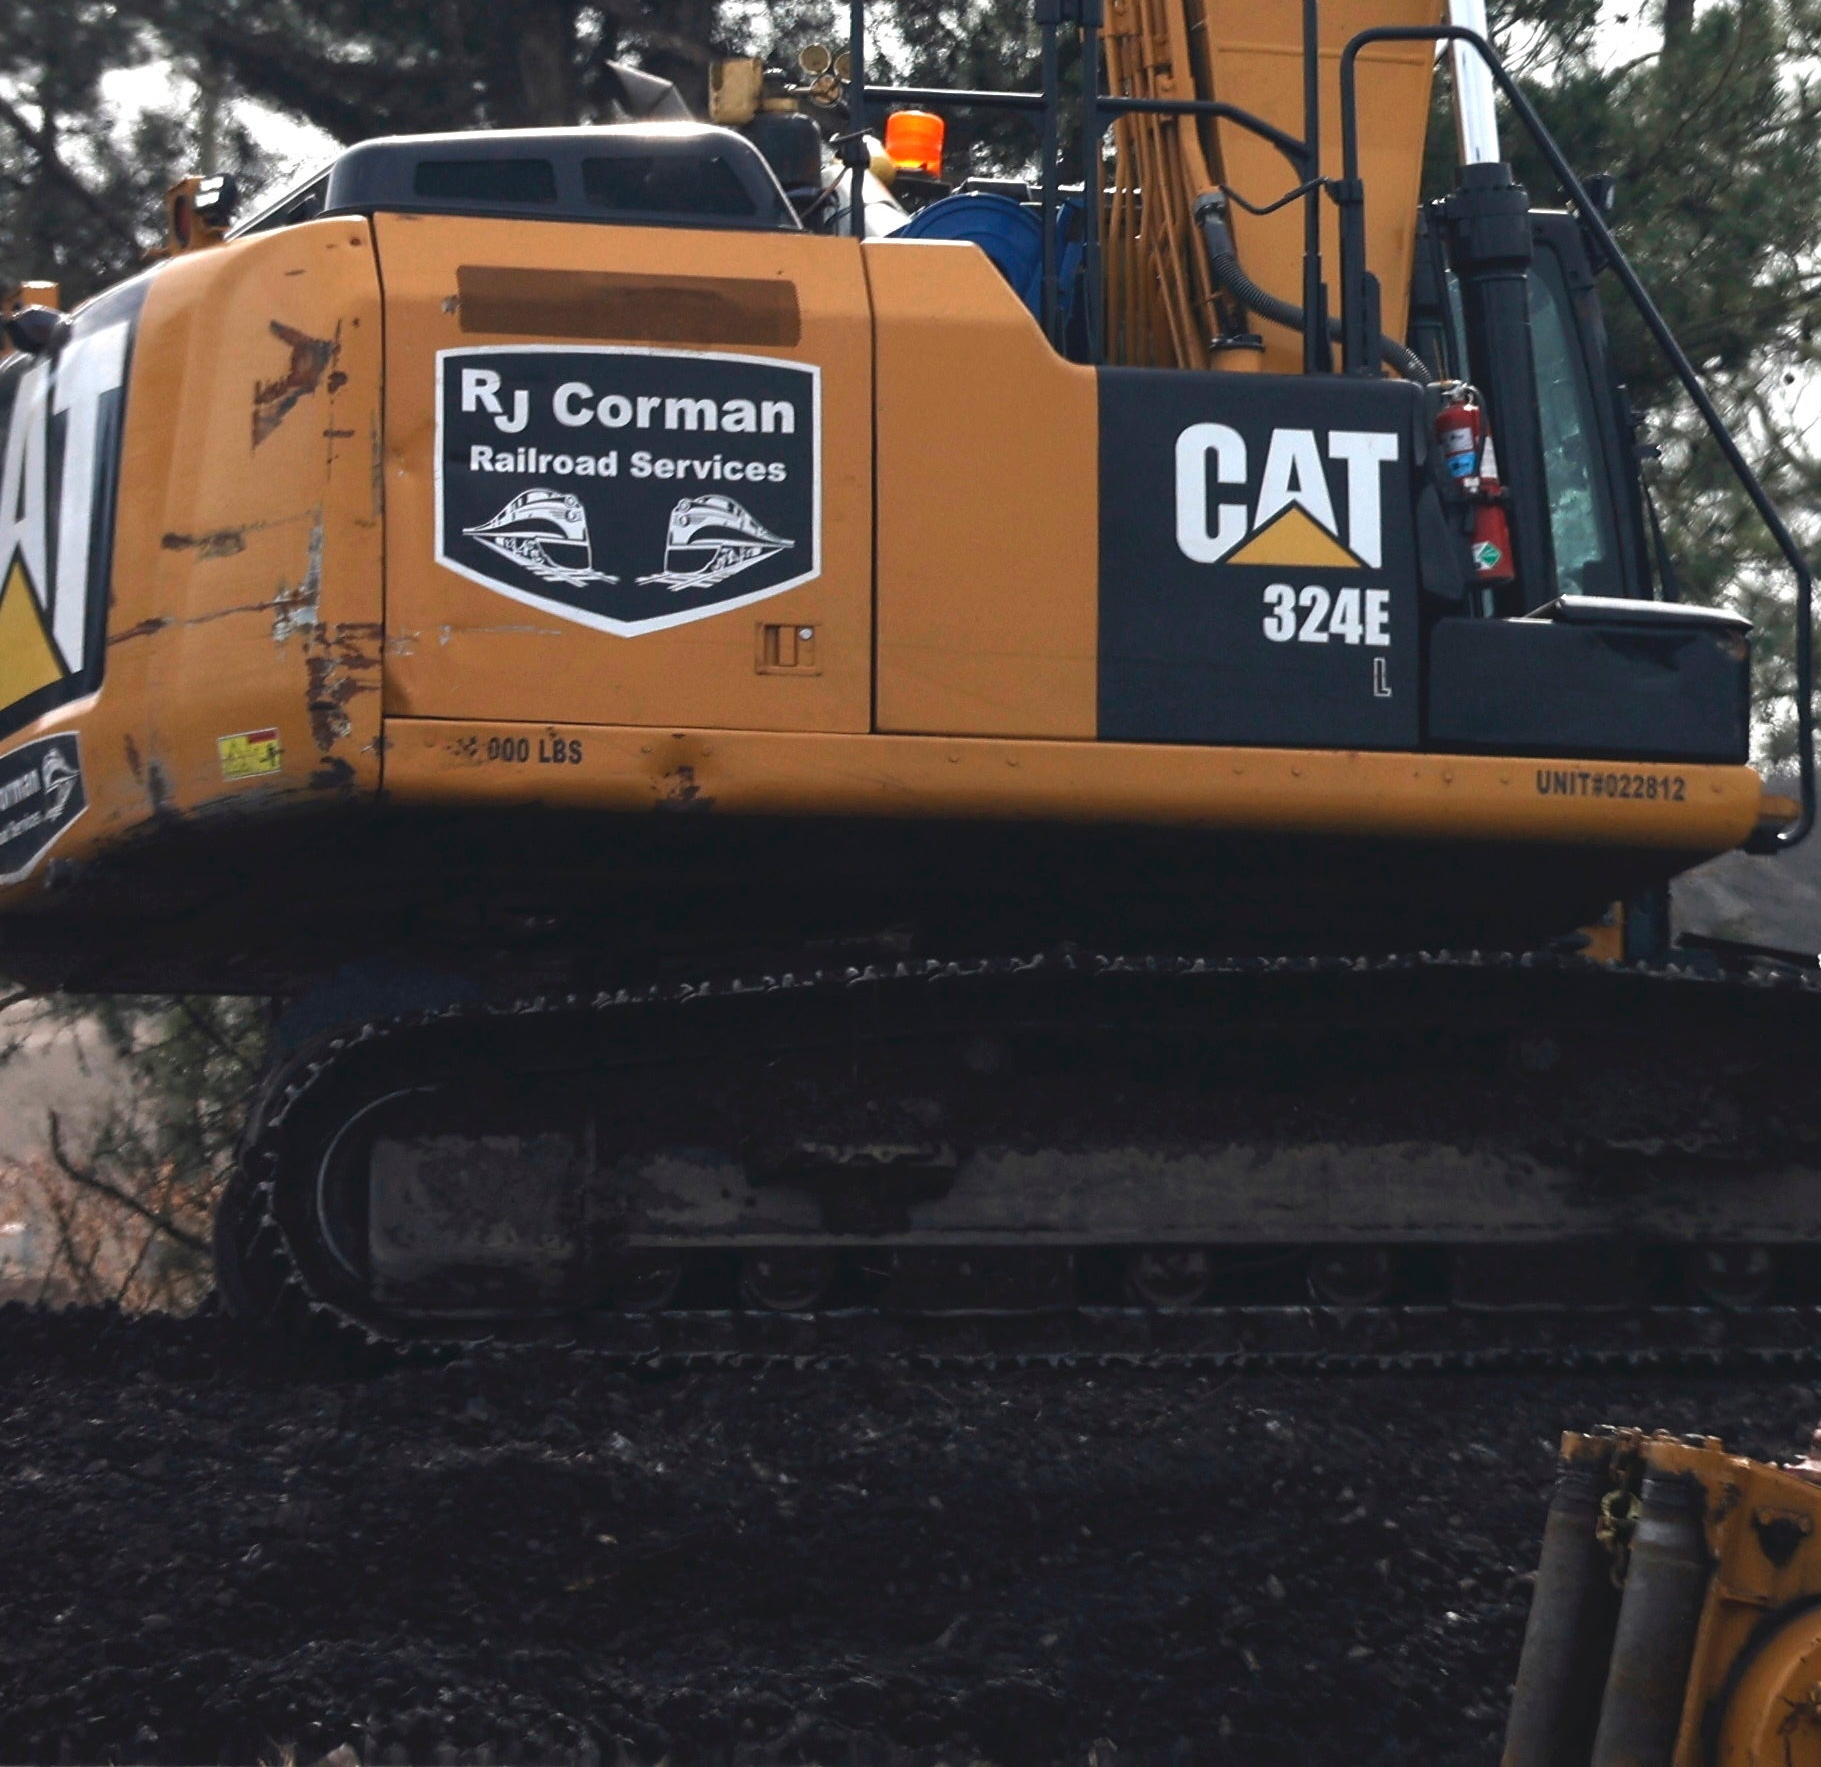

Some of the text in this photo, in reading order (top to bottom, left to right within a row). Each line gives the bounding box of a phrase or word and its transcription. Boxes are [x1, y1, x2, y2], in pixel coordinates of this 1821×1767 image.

[461, 368, 796, 434] RJ Corman
[469, 444, 788, 483] Railroad Services
[1175, 422, 1399, 569] CAT
[1263, 583, 1391, 647] 324E
[1373, 657, 1392, 697] L
[538, 738, 583, 765] LBS
[1535, 769, 1686, 802] UNIT#022812
